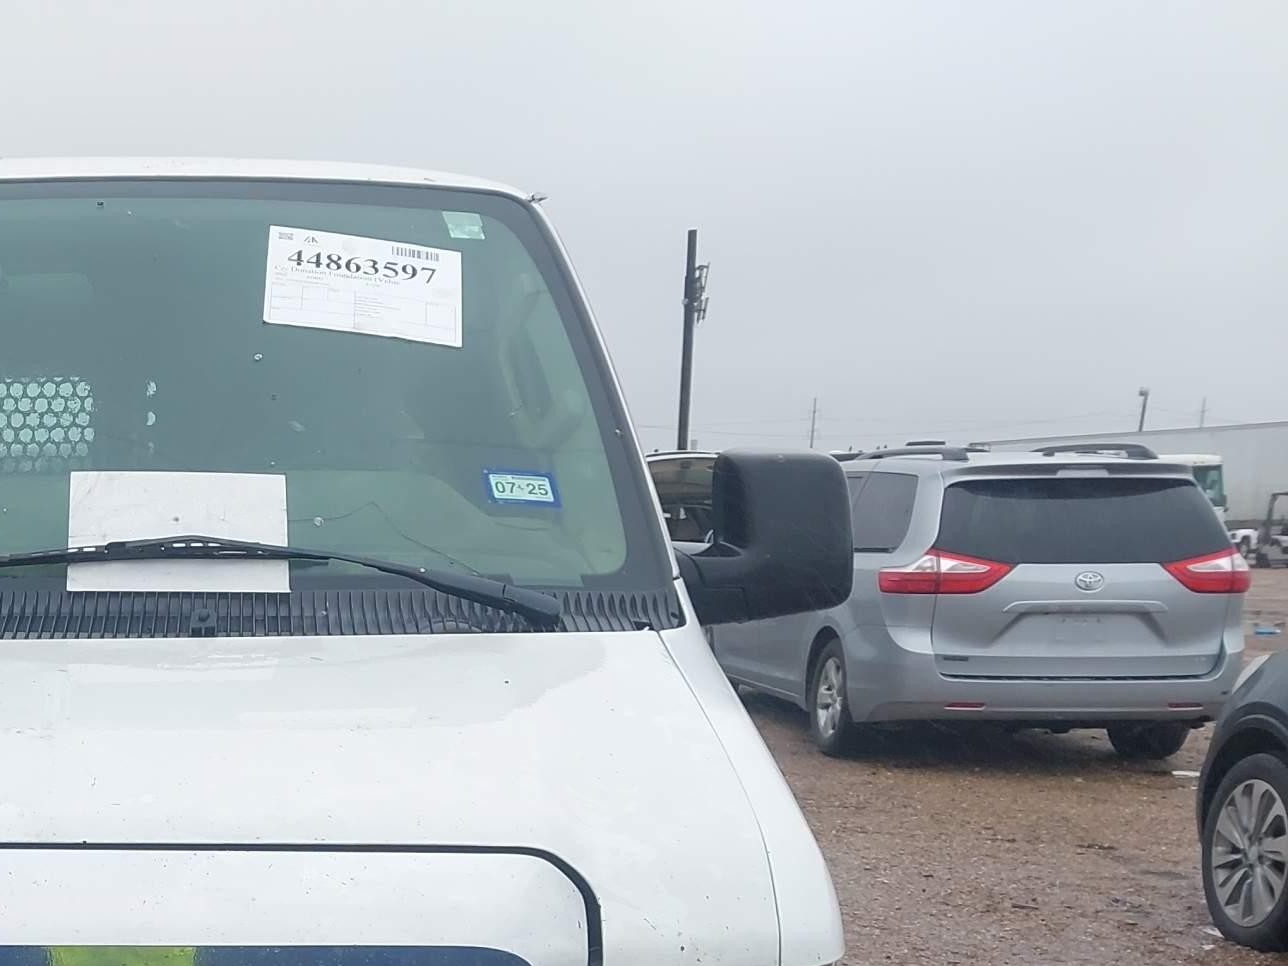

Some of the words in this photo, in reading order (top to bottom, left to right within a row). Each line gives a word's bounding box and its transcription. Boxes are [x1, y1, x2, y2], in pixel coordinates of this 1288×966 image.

[287, 249, 438, 285] 44863597
[495, 481, 516, 494] 07
[526, 482, 549, 496] 25
